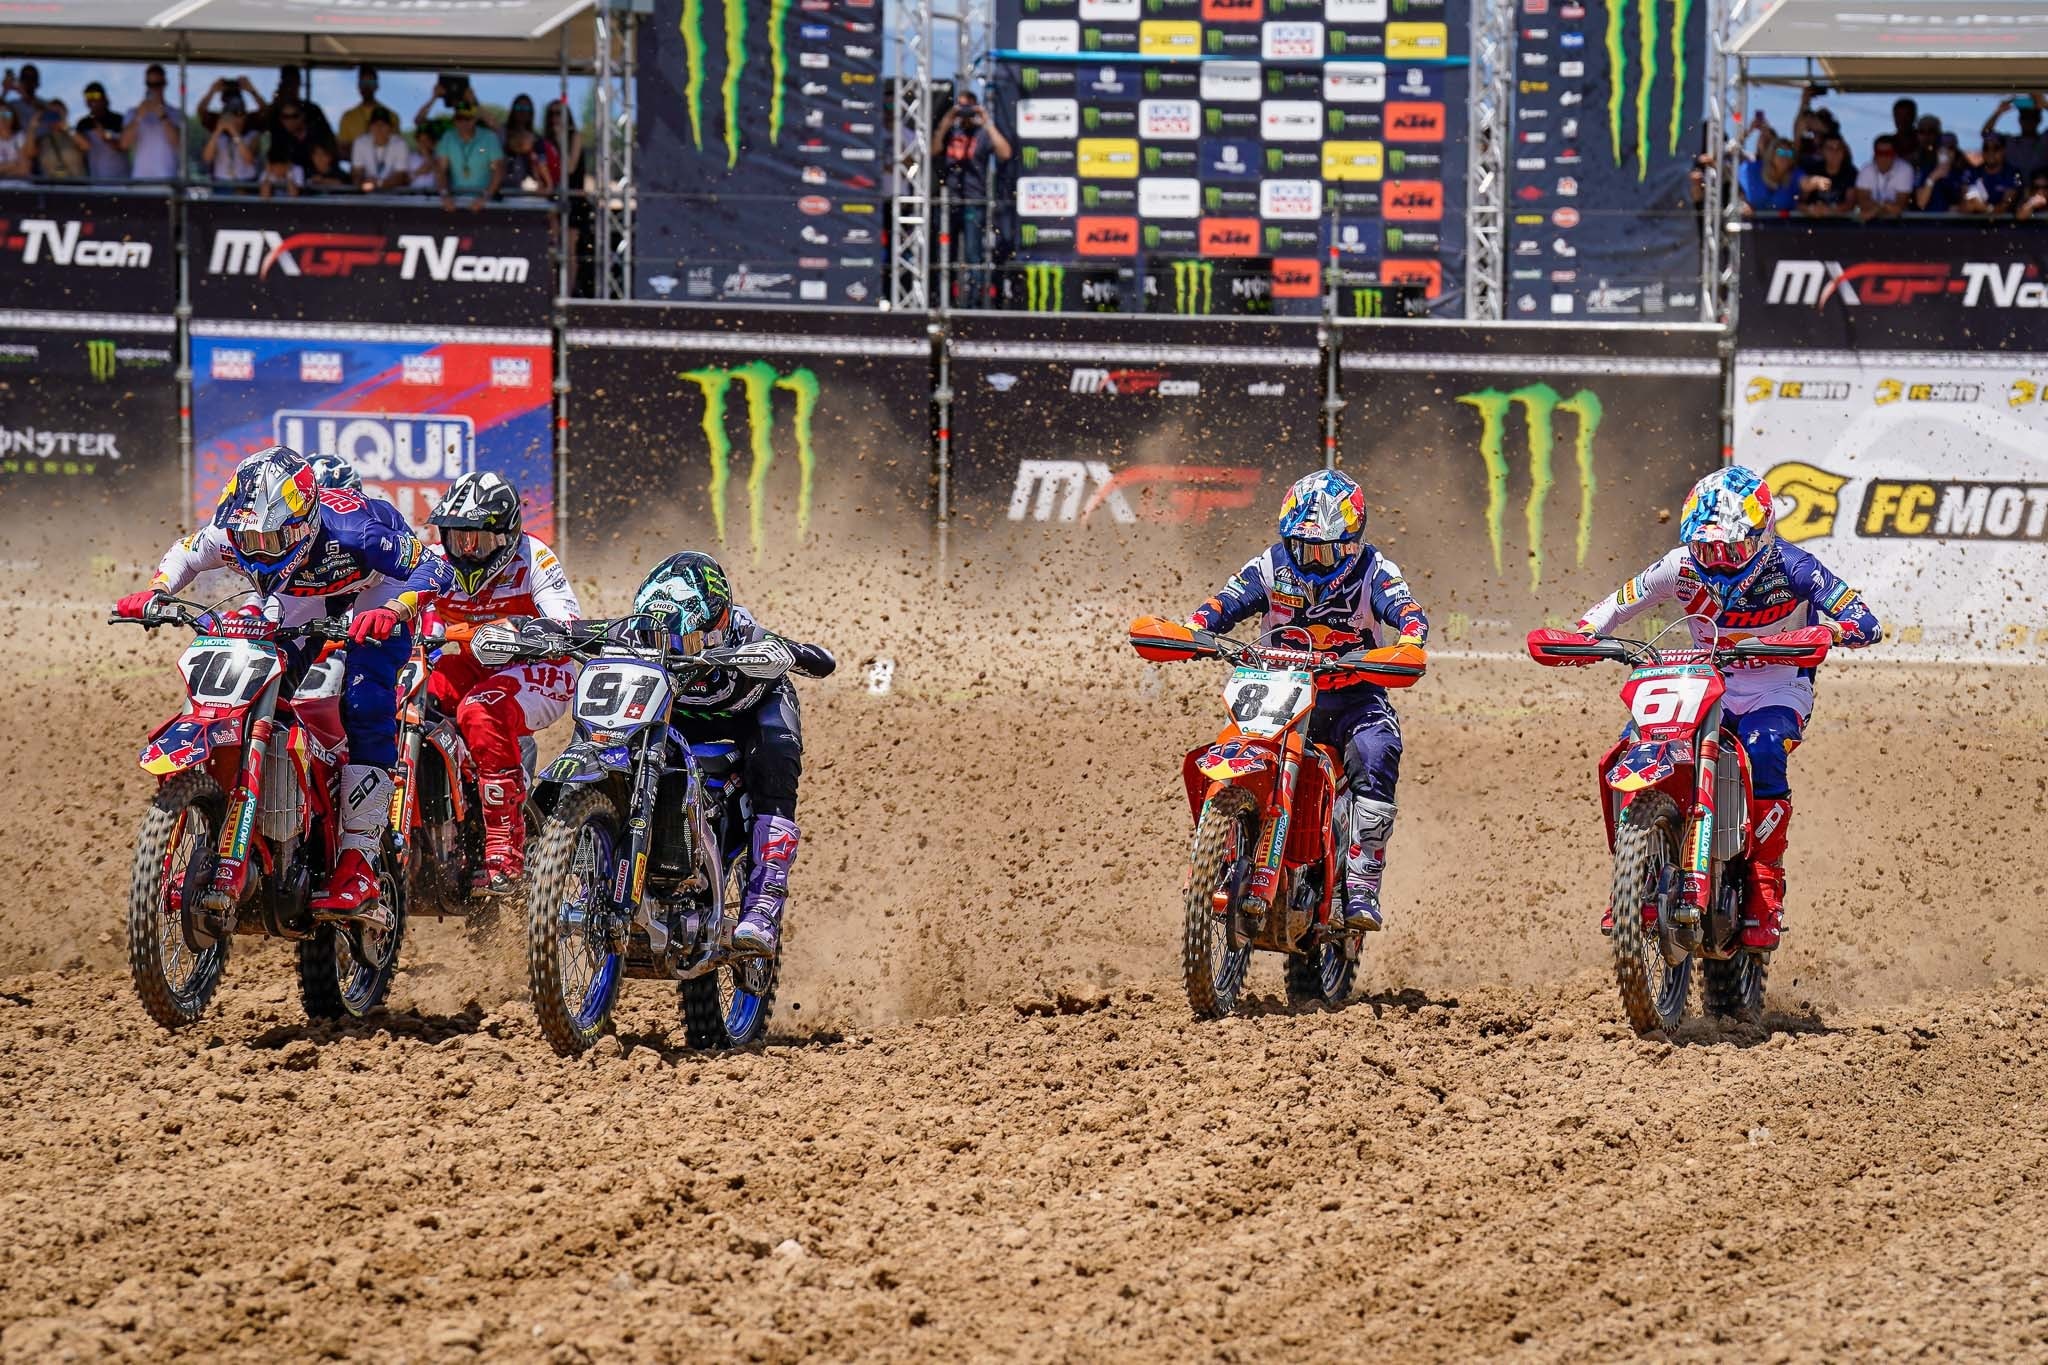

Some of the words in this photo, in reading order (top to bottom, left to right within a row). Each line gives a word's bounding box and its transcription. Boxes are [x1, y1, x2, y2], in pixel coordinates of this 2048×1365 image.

[0, 426, 121, 460] ONSTER
[285, 418, 463, 480] LIQUI
[2, 460, 97, 475] NERGY
[1007, 459, 1263, 528] MXP
[221, 618, 269, 627] ENTHAL
[652, 602, 674, 612] SHOEI
[1724, 599, 1798, 627] THOR
[203, 638, 233, 647] MOTOR
[482, 642, 521, 652] ACERBIS
[728, 654, 769, 664] ACERBIS
[188, 650, 278, 701] 101
[528, 685, 573, 702] PLAS
[579, 672, 660, 716] 91
[1631, 678, 1711, 727] 61
[349, 769, 381, 811] SIDI
[241, 796, 257, 845] MOTOREX
[1273, 814, 1288, 856] MOTOREX
[1701, 812, 1713, 858] MOTOREX
[1755, 801, 1785, 845] SIDI
